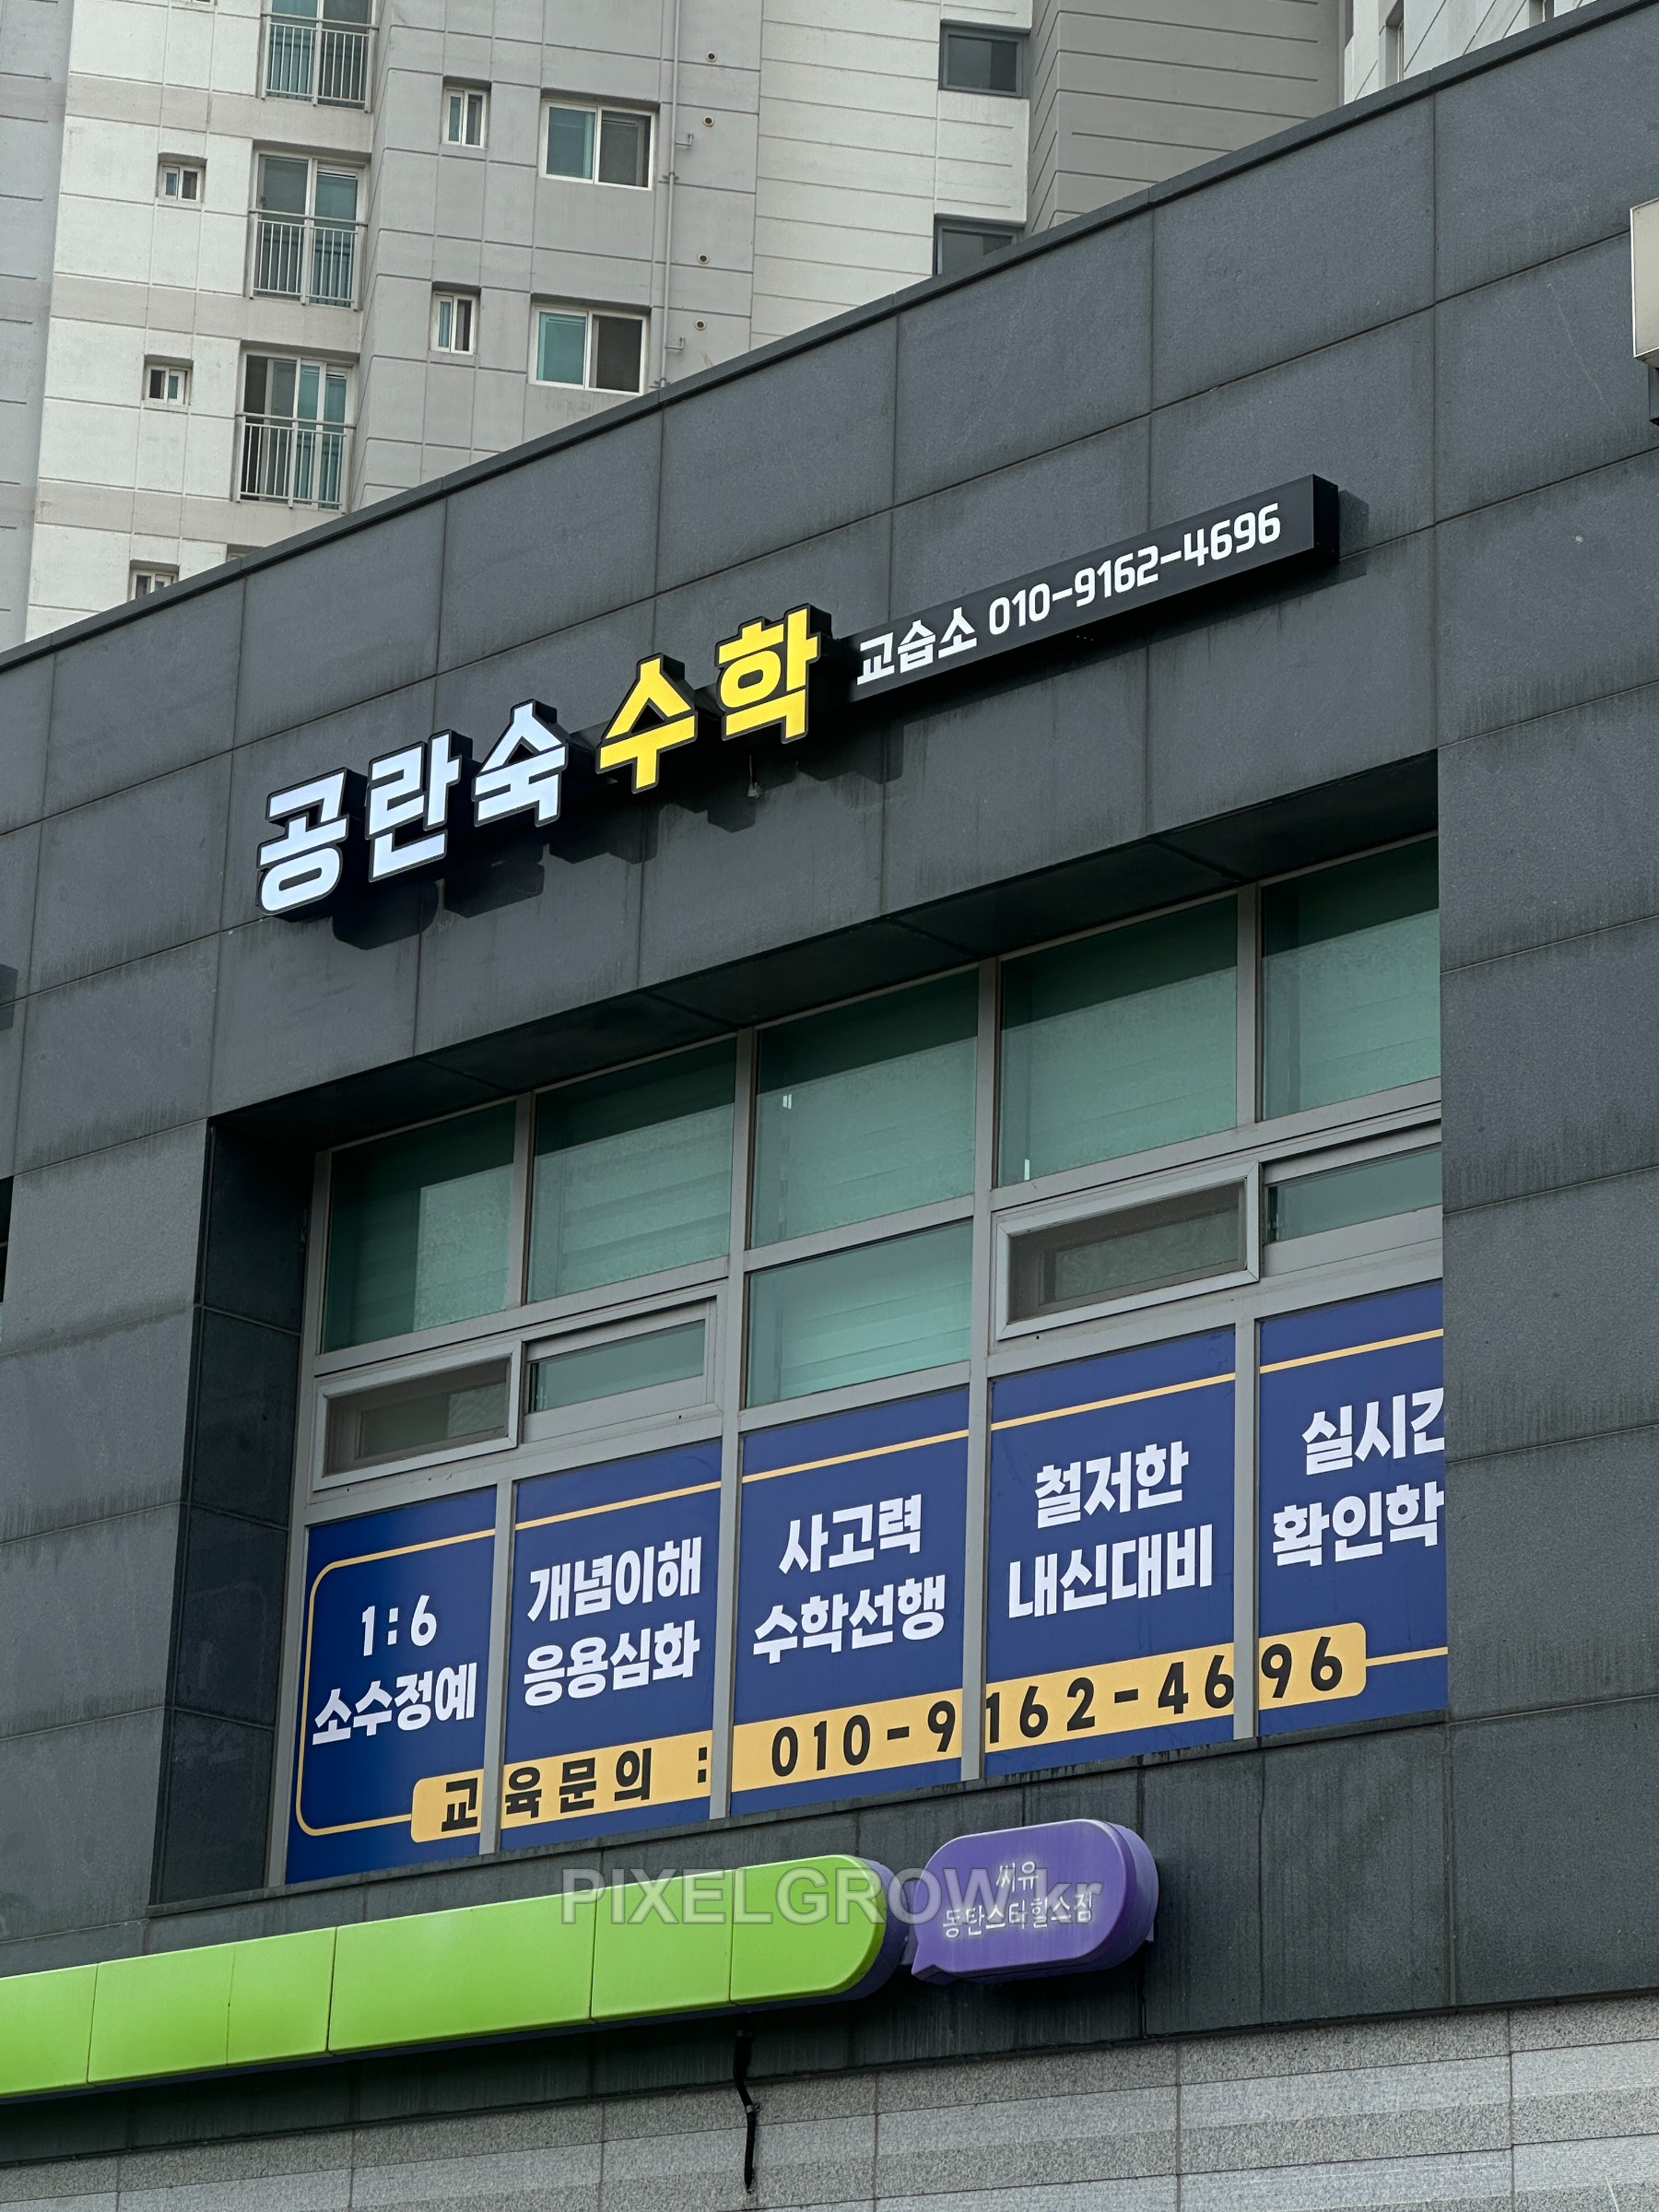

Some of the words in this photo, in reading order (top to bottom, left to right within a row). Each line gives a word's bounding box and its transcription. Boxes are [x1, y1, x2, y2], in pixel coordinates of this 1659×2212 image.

[856, 606, 977, 686] 교습소
[989, 502, 1281, 635] 010-9162-4696
[258, 700, 568, 912] 공란숙
[599, 606, 819, 791] 수학
[1034, 1441, 1189, 1529] 철저한
[778, 1493, 923, 1574] 사고력
[1008, 1524, 1214, 1618] 내신대비
[526, 1535, 702, 1622] 개념이해
[753, 1574, 947, 1665] 수학선행
[361, 1594, 438, 1657] 1:6
[524, 1619, 700, 1707] 응용심화
[312, 1662, 477, 1746] 소수정예
[441, 1747, 653, 1833] 교육문의
[771, 1636, 1344, 1777] 010-9162-4696
[995, 1861, 1040, 1893] 씨유
